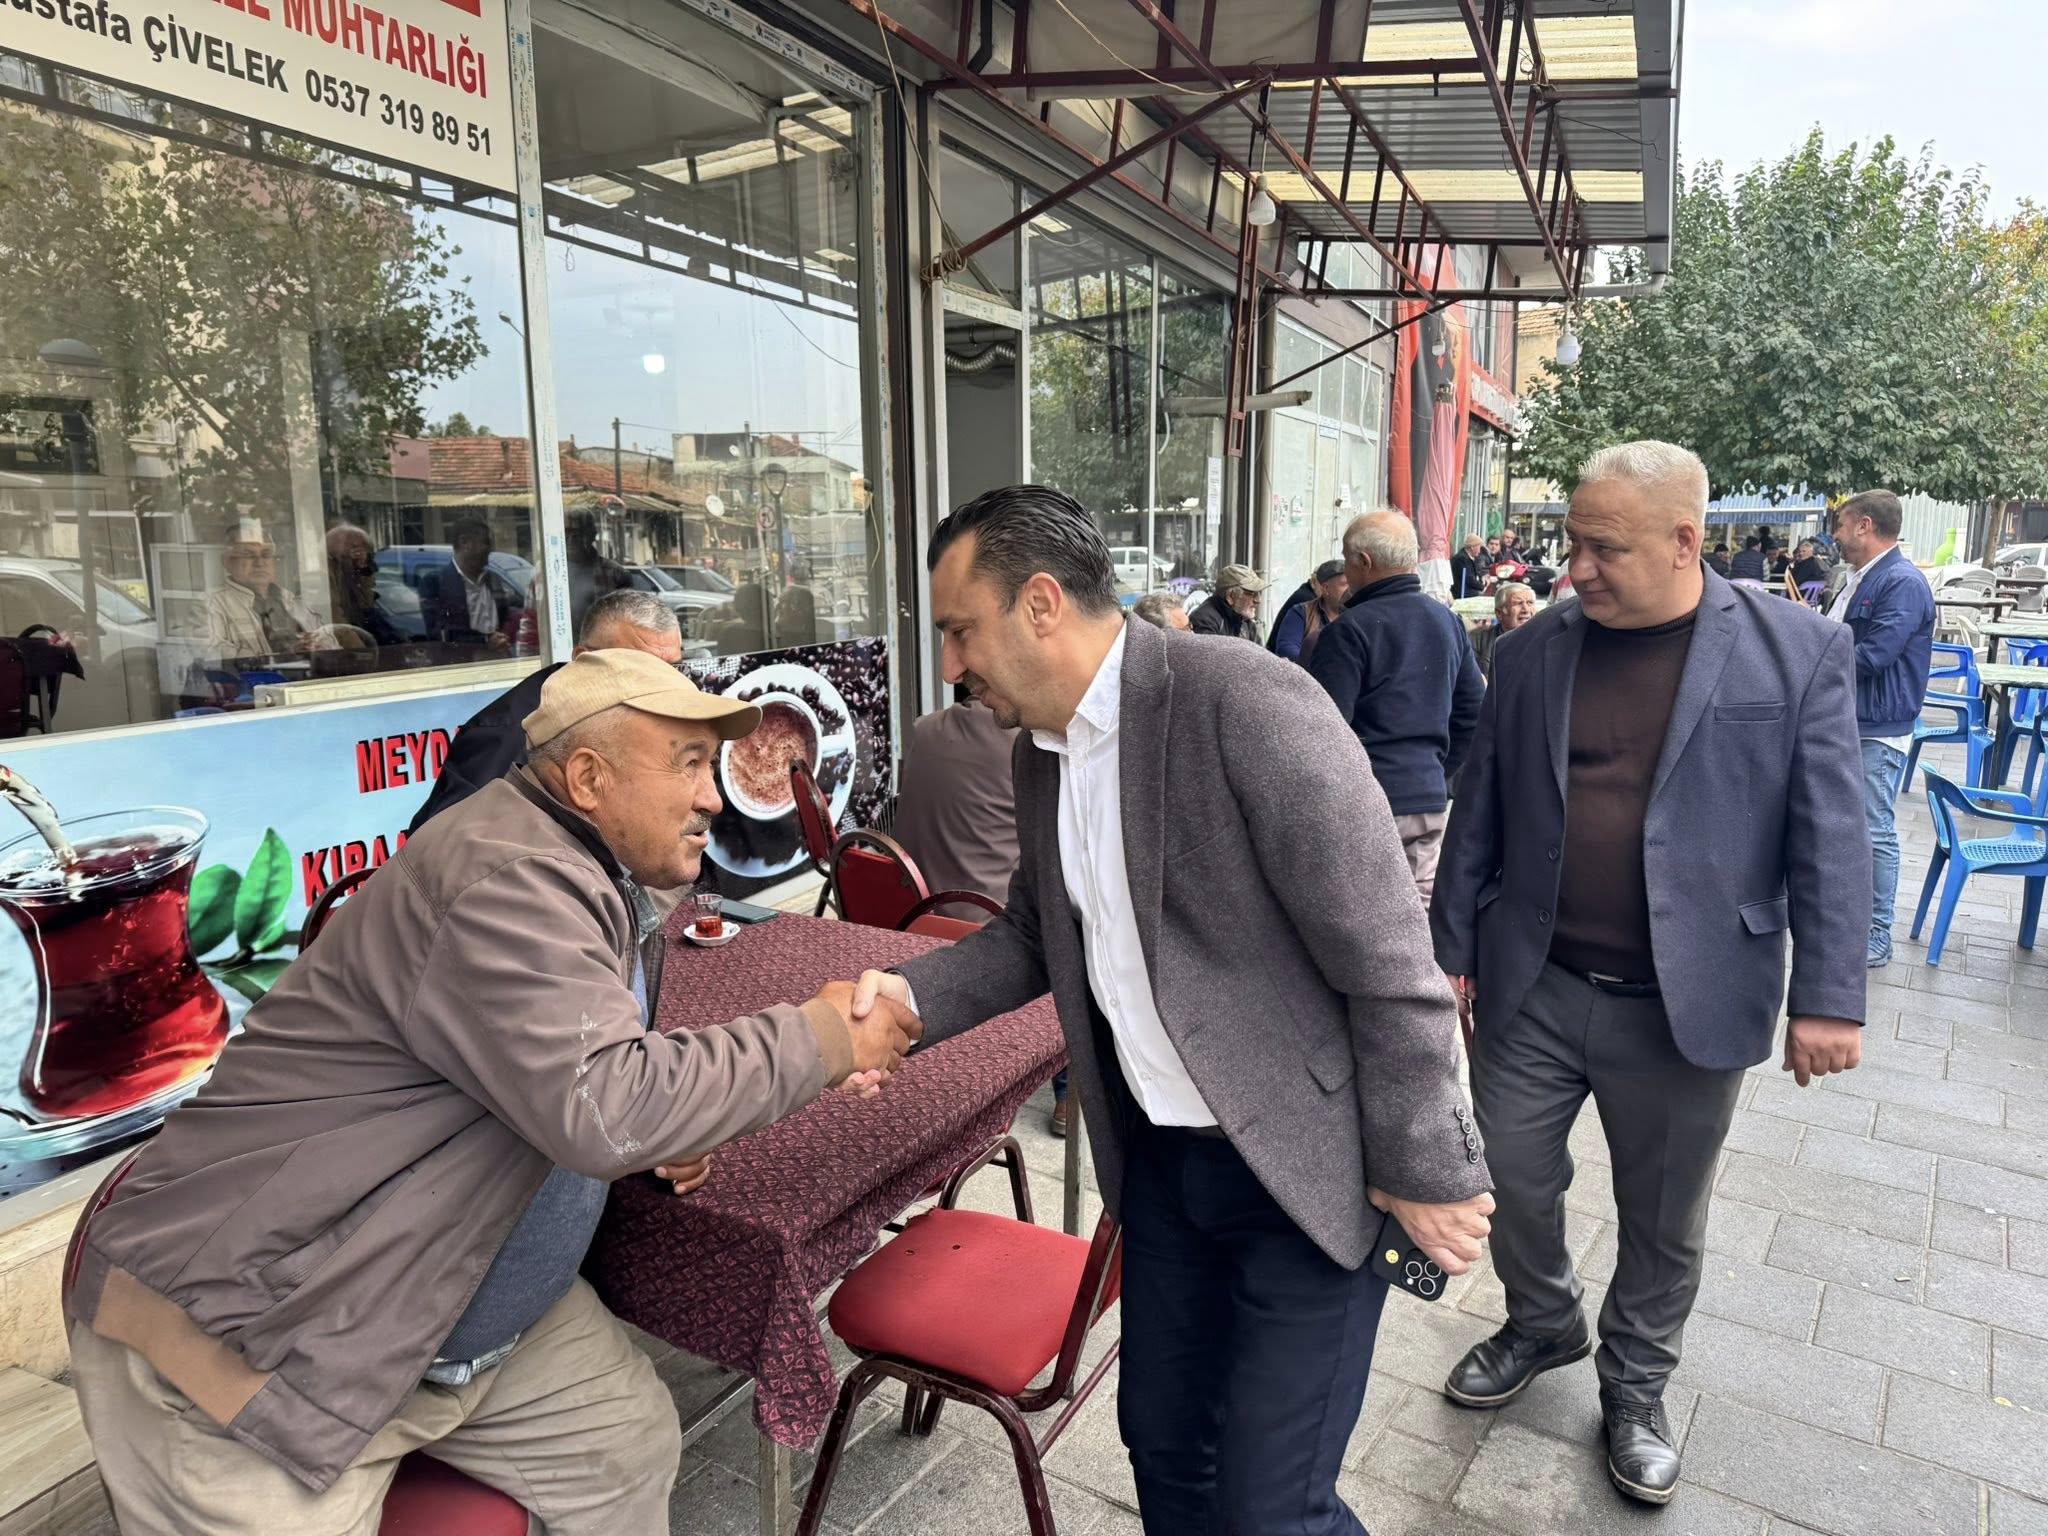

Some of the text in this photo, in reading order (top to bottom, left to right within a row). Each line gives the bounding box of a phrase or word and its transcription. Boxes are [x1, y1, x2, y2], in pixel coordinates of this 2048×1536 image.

[0, 0, 491, 156] stafa ÇİVELEK 0537 319 89 51
[283, 0, 487, 98] MUHTARLIĞI
[355, 725, 464, 794] MEYD
[302, 829, 409, 906] KIRA
